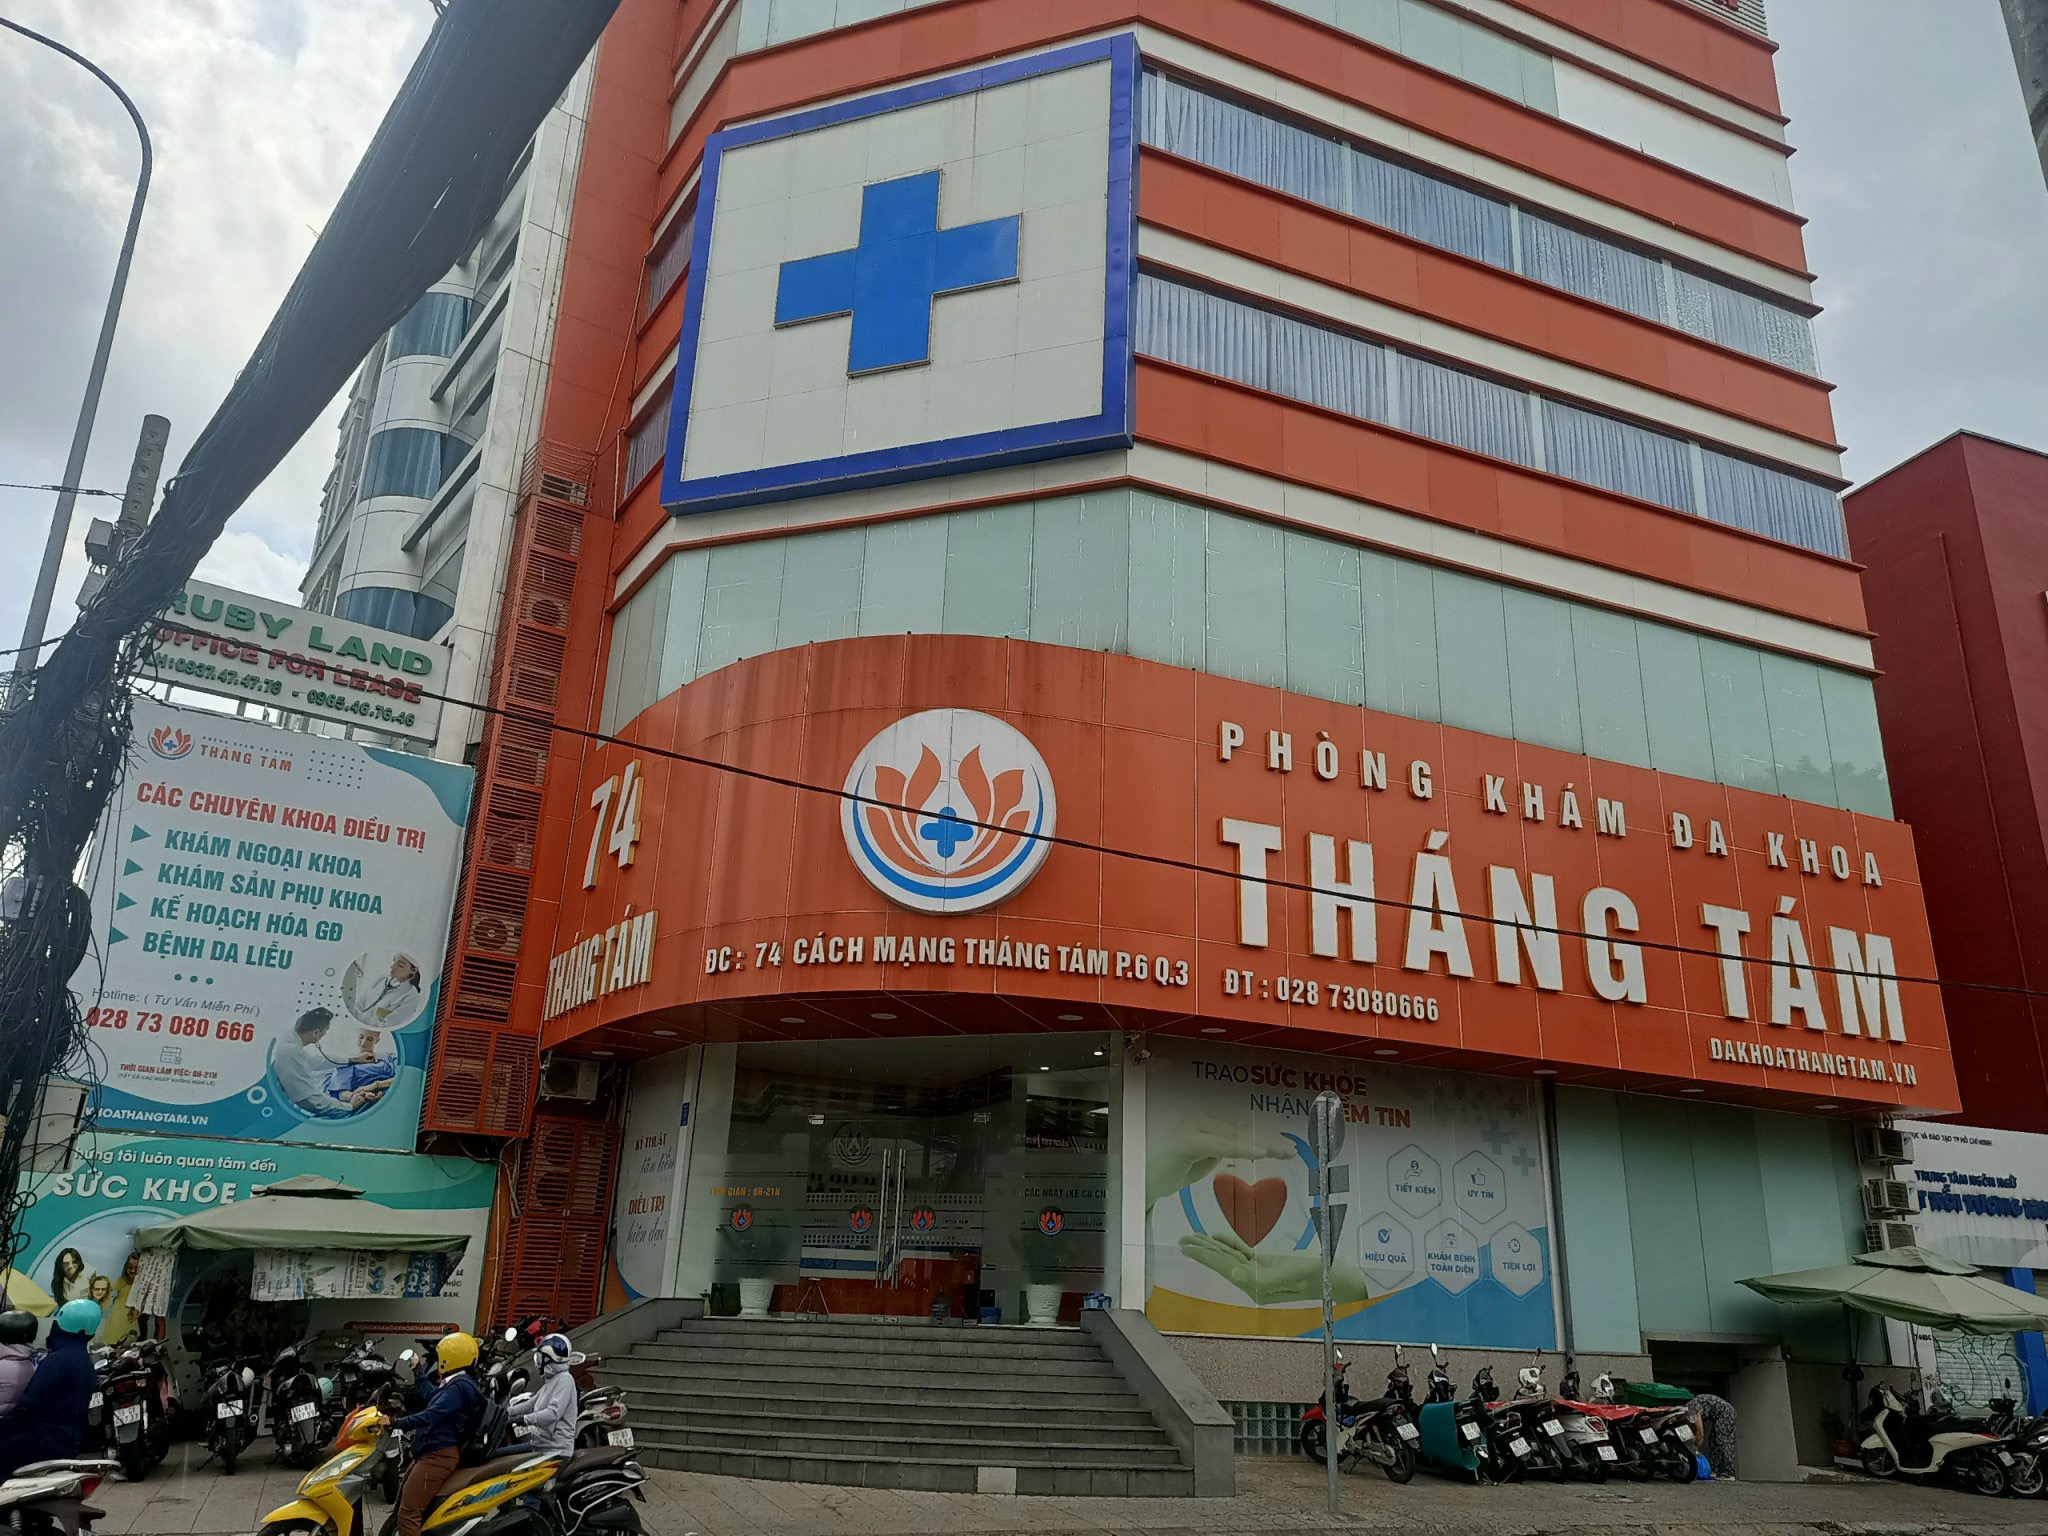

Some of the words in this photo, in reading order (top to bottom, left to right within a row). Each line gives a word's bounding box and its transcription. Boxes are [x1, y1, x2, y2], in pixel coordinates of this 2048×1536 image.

[155, 627, 262, 664] OFFICE
[268, 648, 326, 680] FOR
[333, 664, 424, 704] LEASE
[308, 626, 433, 676] LAND
[201, 744, 252, 765] THÁNG
[260, 754, 293, 773] TÁM
[137, 781, 184, 808] CÁC
[189, 790, 277, 824] CHUYÊN
[281, 806, 337, 835] KHOA
[343, 815, 391, 844] ĐIỀU
[396, 825, 427, 854] TRỊ
[582, 758, 645, 891] 74
[1218, 719, 1433, 801] PHÒNG
[1481, 772, 1628, 838] KHÁM
[1670, 810, 1729, 858] ĐA
[1764, 830, 1883, 888] KHOA
[164, 828, 232, 858] KHÁM
[236, 840, 304, 872] NGOẠI
[307, 851, 362, 879] KHOA
[157, 862, 225, 892] KHÁM
[230, 869, 276, 901] SẢN
[280, 881, 325, 910] PHỤ
[328, 888, 383, 915] KHOA
[150, 894, 185, 920] KẾ
[185, 901, 262, 931] HOẠCH
[265, 911, 308, 938] HÓA
[314, 920, 344, 942] GĐ
[1220, 815, 1648, 1004] THÁNG
[1699, 895, 1907, 1043] TÁM
[142, 929, 206, 960] BỆNH
[209, 940, 239, 964] DA
[245, 940, 294, 970] LIỄU
[544, 931, 605, 1022] THÁNG
[600, 903, 659, 997] TÁM
[755, 941, 784, 969] 74
[792, 931, 865, 965] CÁCH
[873, 935, 957, 968] MẠNG
[963, 935, 1051, 970] THÁNG
[1057, 941, 1110, 976] TÁM
[1115, 951, 1149, 980] P.6
[1155, 956, 1190, 986] Q.3
[92, 988, 140, 1003] Hotline:
[1275, 976, 1320, 1006] 028
[1325, 983, 1440, 1021] 73080666
[86, 1007, 129, 1030] 028
[136, 1011, 163, 1034] 73
[169, 1015, 210, 1038] 080
[215, 1020, 256, 1043] 666
[1191, 1061, 1249, 1083] TRAO
[1250, 1062, 1299, 1088] SỨC
[1303, 1067, 1367, 1097] KHỎE
[1250, 1092, 1310, 1119] NHẬN
[1374, 1105, 1412, 1129] TIN
[118, 1149, 138, 1163] tôi
[140, 1150, 173, 1165] luôn
[176, 1154, 214, 1169] quan
[218, 1156, 247, 1170] tâm
[250, 1157, 278, 1172] đến
[142, 1173, 238, 1205] KHỎE
